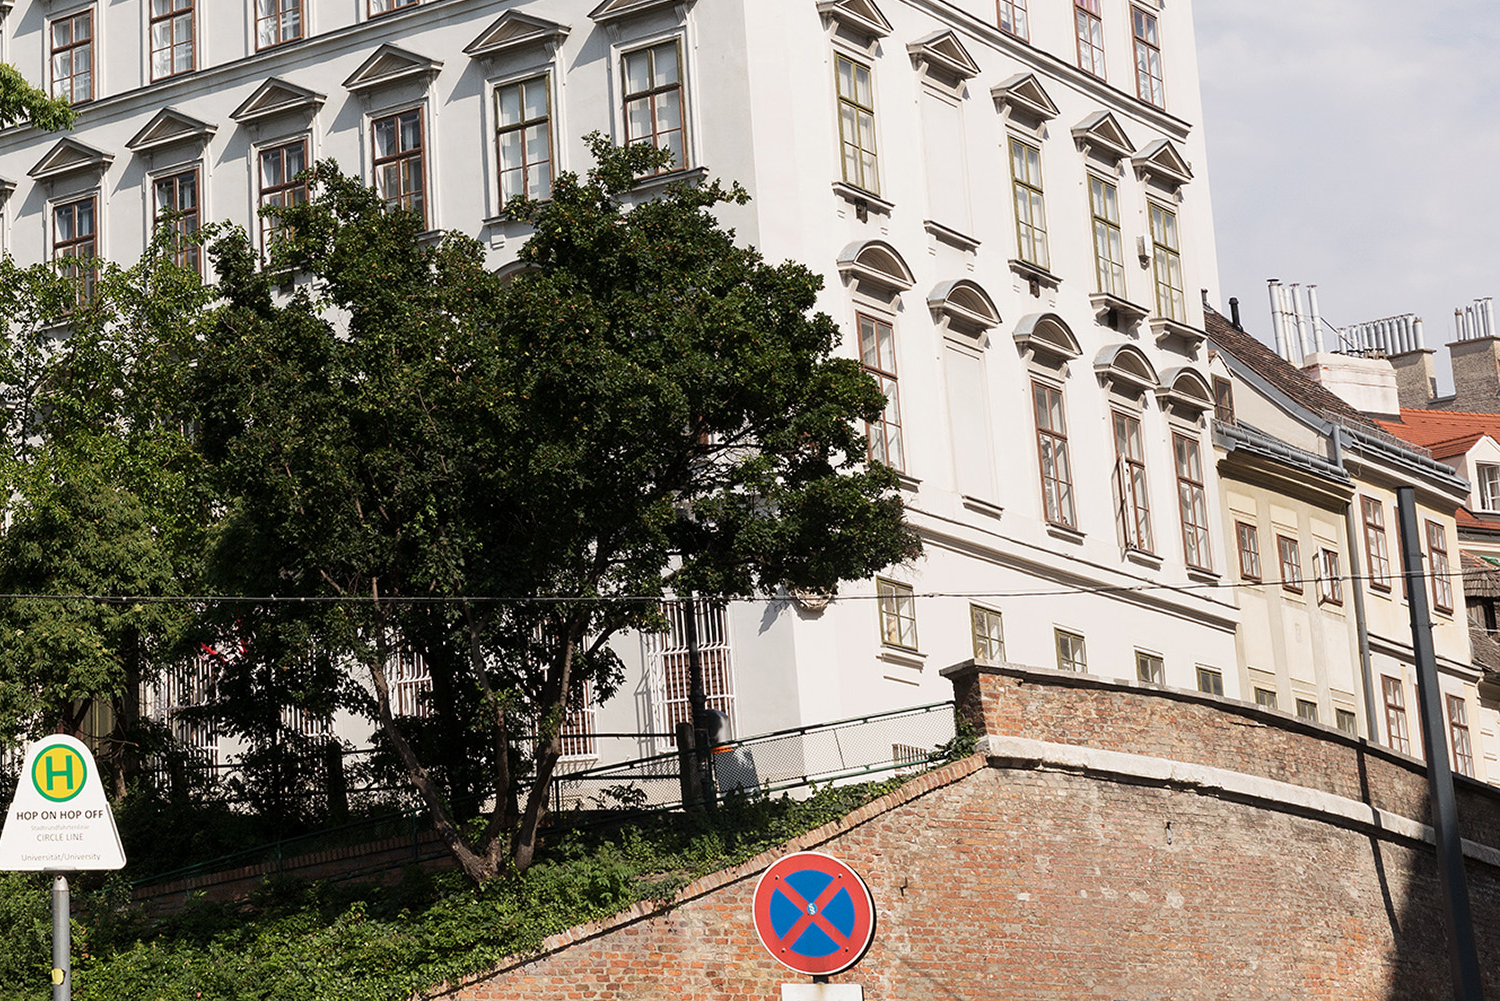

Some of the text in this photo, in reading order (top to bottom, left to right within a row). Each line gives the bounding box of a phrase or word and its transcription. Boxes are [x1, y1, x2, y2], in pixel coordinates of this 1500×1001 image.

[46, 755, 73, 791] H
[16, 809, 104, 821] HOP ON HOP OFF
[36, 833, 84, 842] CIRCLE LINE
